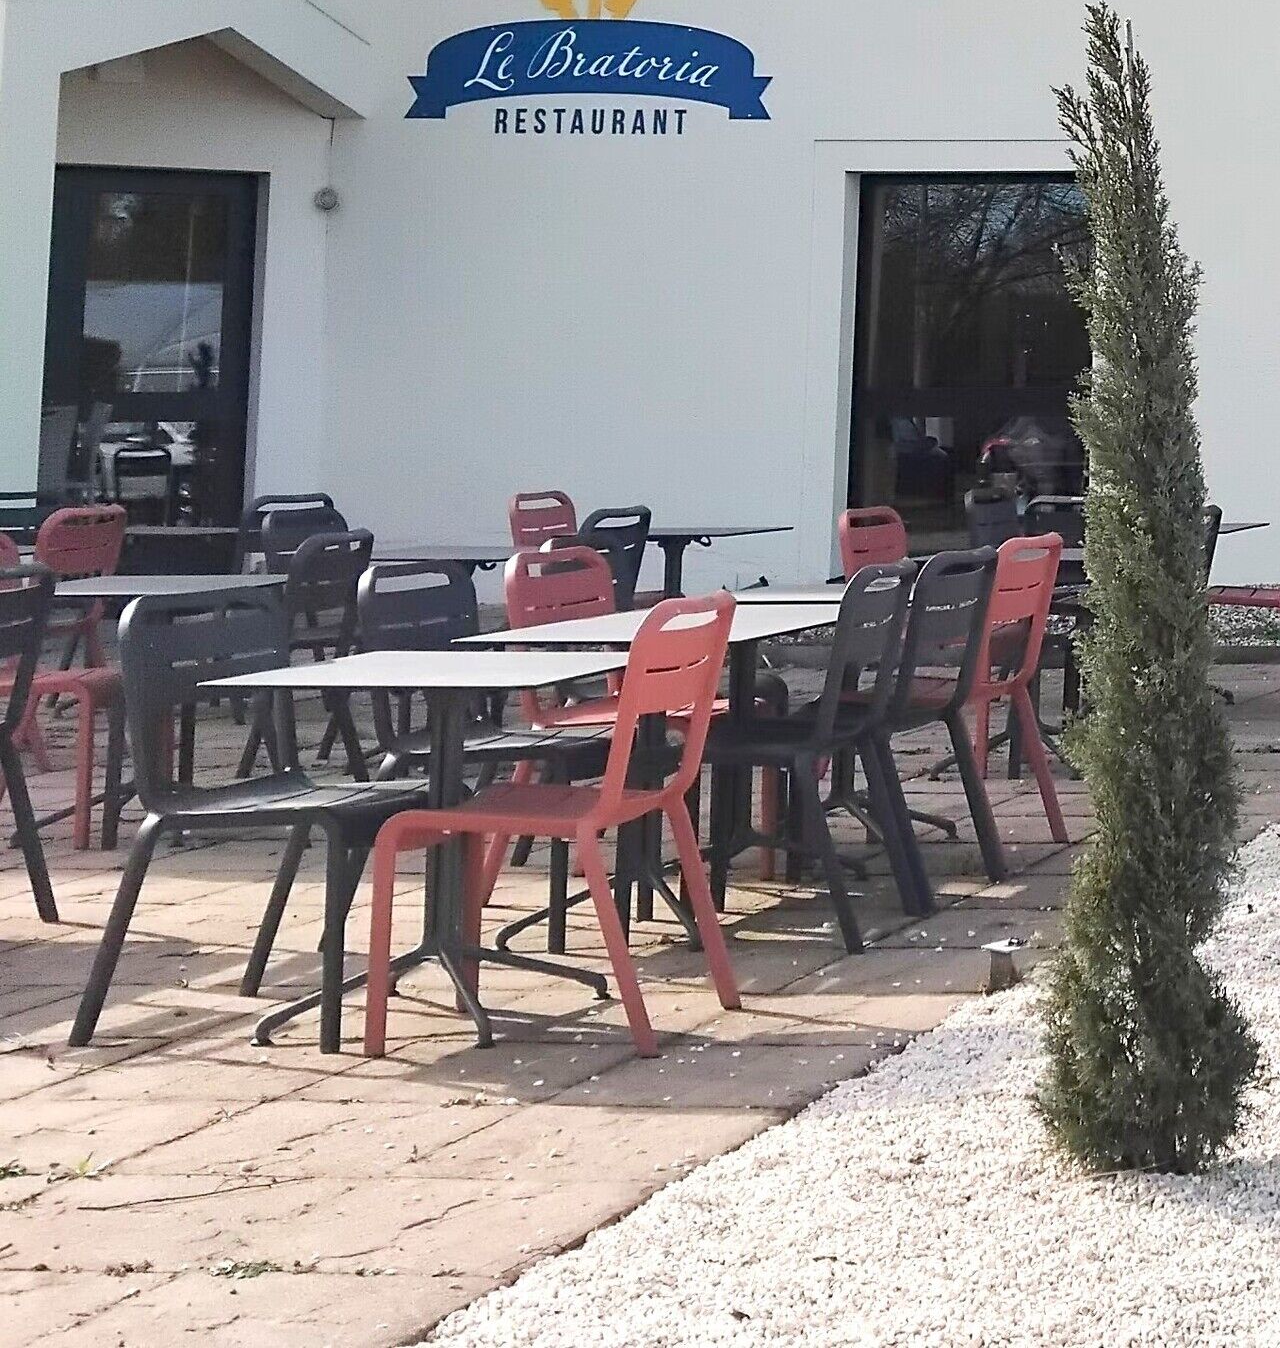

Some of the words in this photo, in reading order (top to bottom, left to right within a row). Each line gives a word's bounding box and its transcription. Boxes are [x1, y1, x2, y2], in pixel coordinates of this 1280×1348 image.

[464, 31, 516, 91] Le
[526, 25, 719, 89] Bratoria
[493, 107, 688, 135] RESTAURANT
